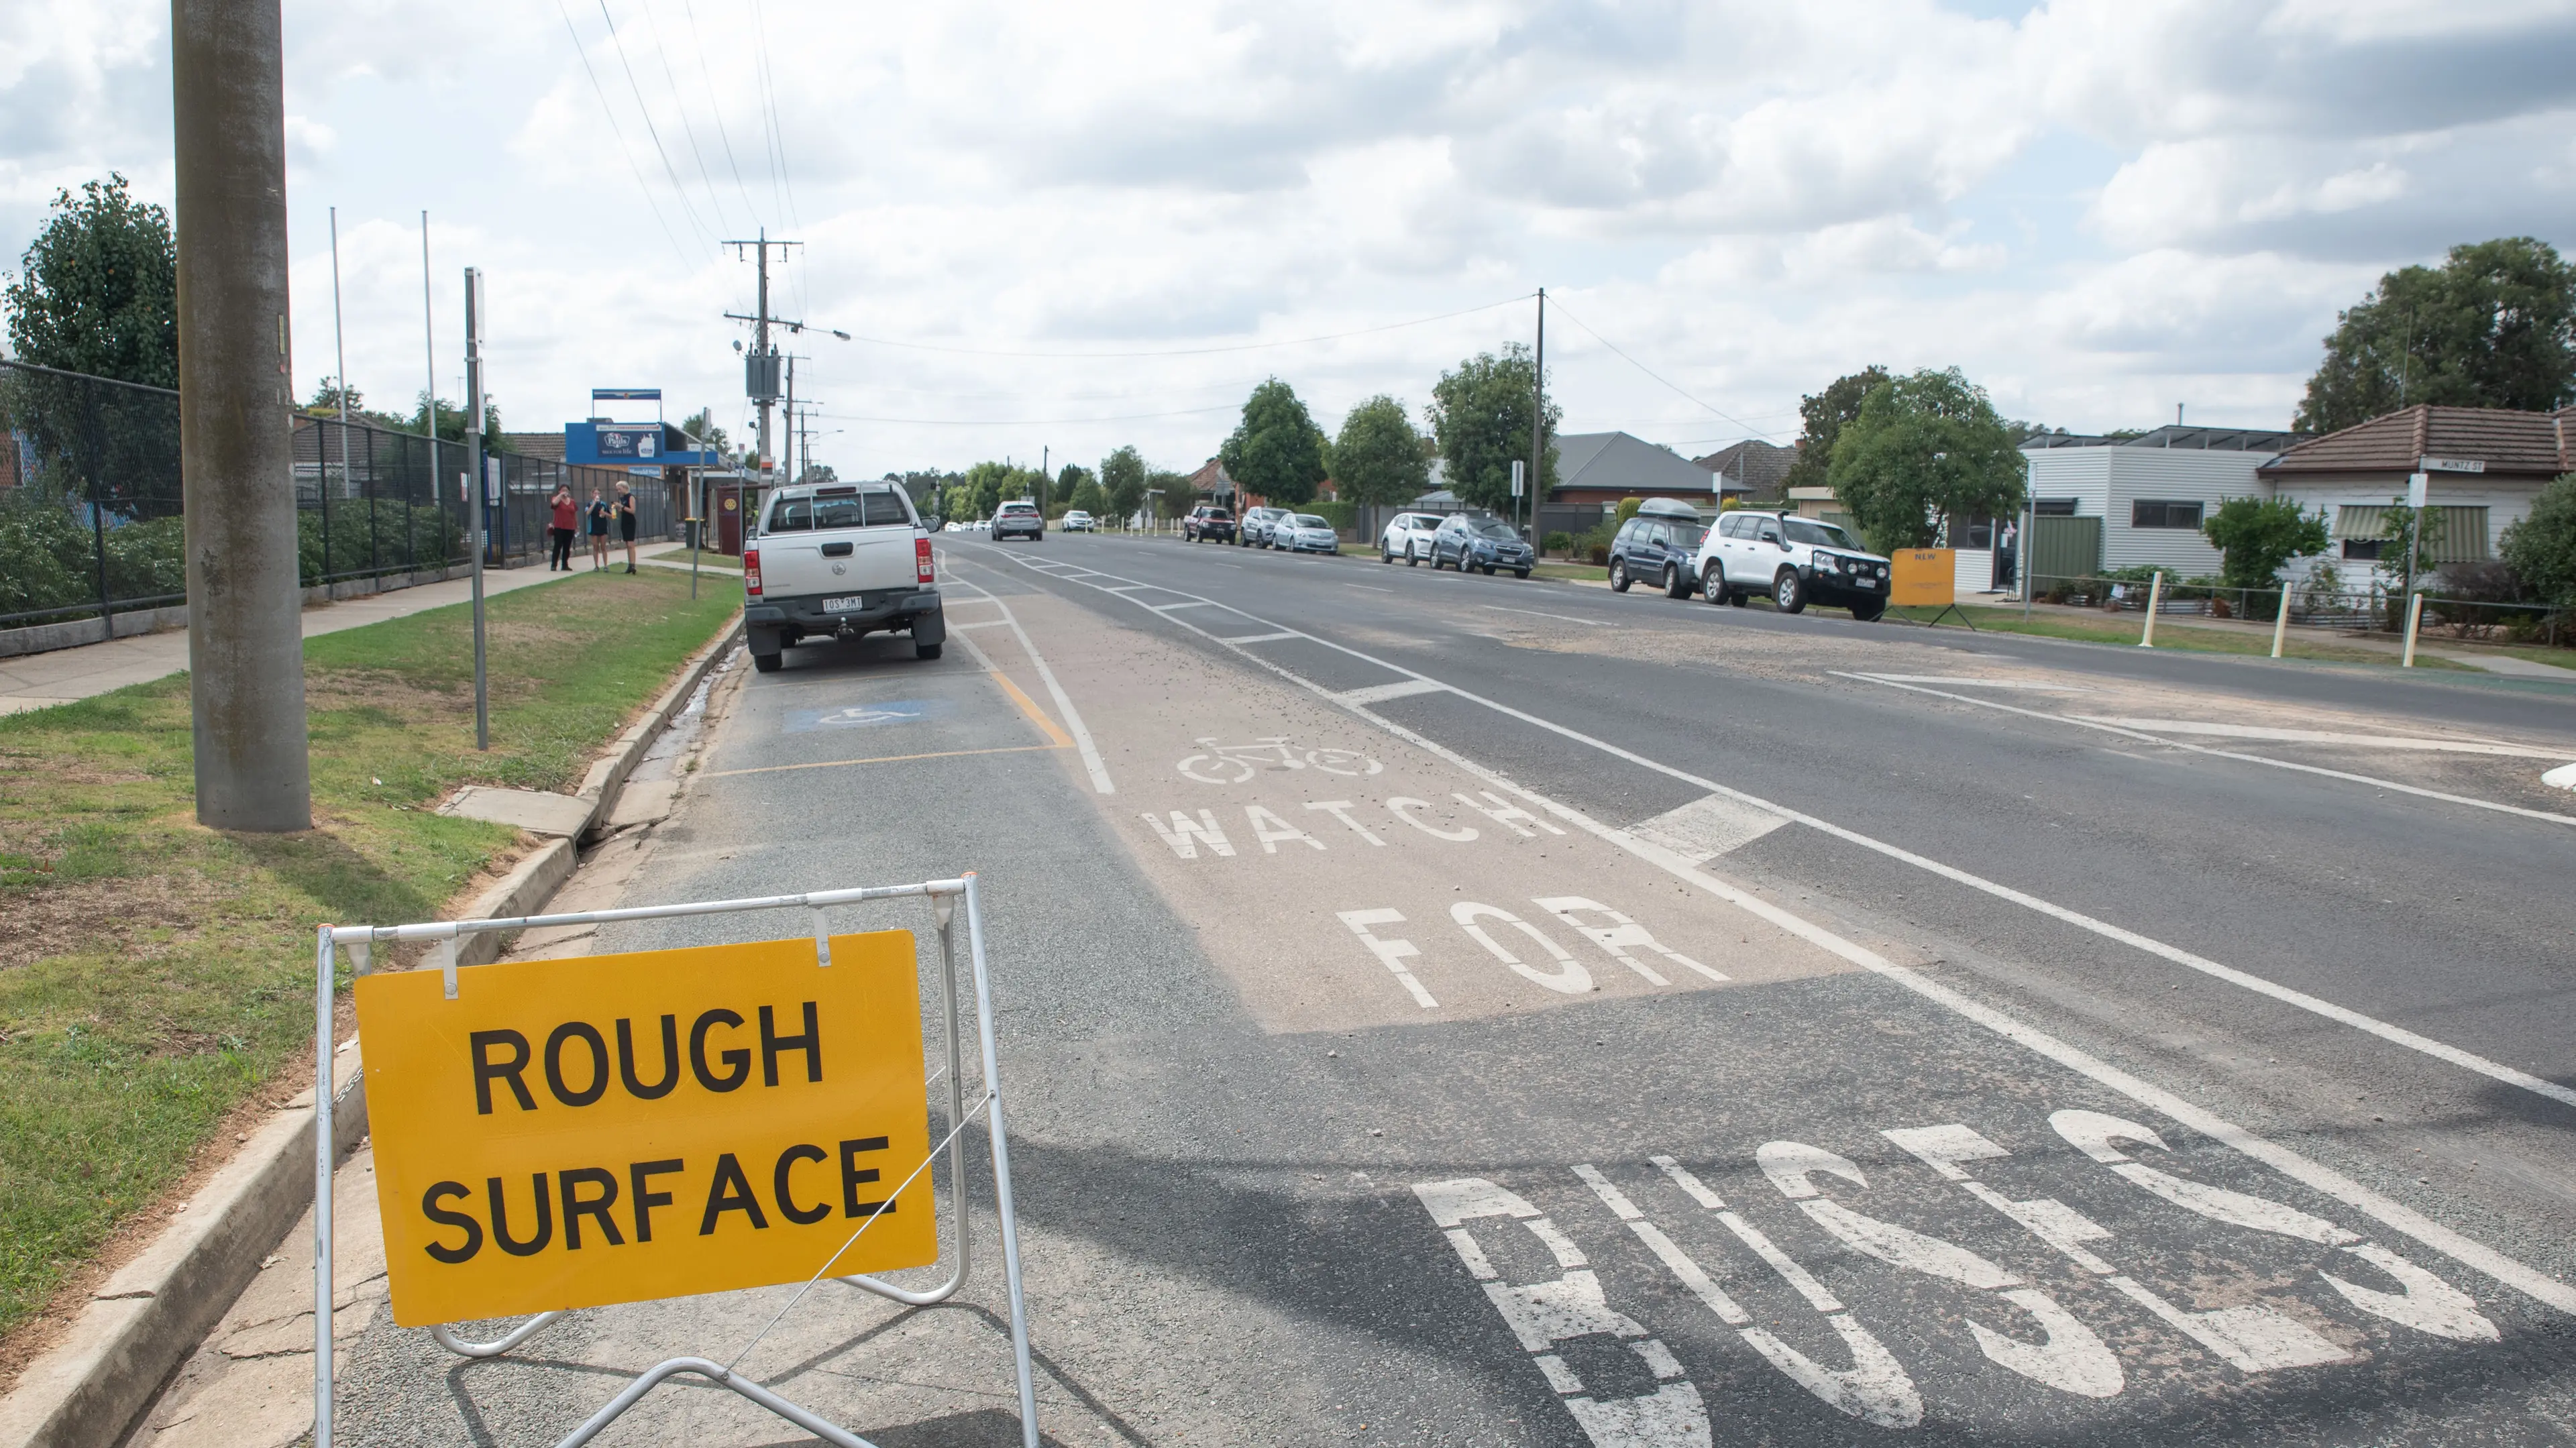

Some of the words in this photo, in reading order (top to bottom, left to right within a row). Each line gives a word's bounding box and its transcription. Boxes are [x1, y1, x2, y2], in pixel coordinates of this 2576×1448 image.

[2441, 460, 2470, 470] MUNTZ
[2472, 461, 2482, 470] ST
[846, 598, 861, 608] 3MT
[1142, 791, 1567, 859] WATCH
[1335, 895, 1732, 1009] FOR
[470, 1001, 823, 1115] ROUGH
[421, 1135, 898, 1264] SURFACE
[1411, 1109, 2501, 1448] BUSES
